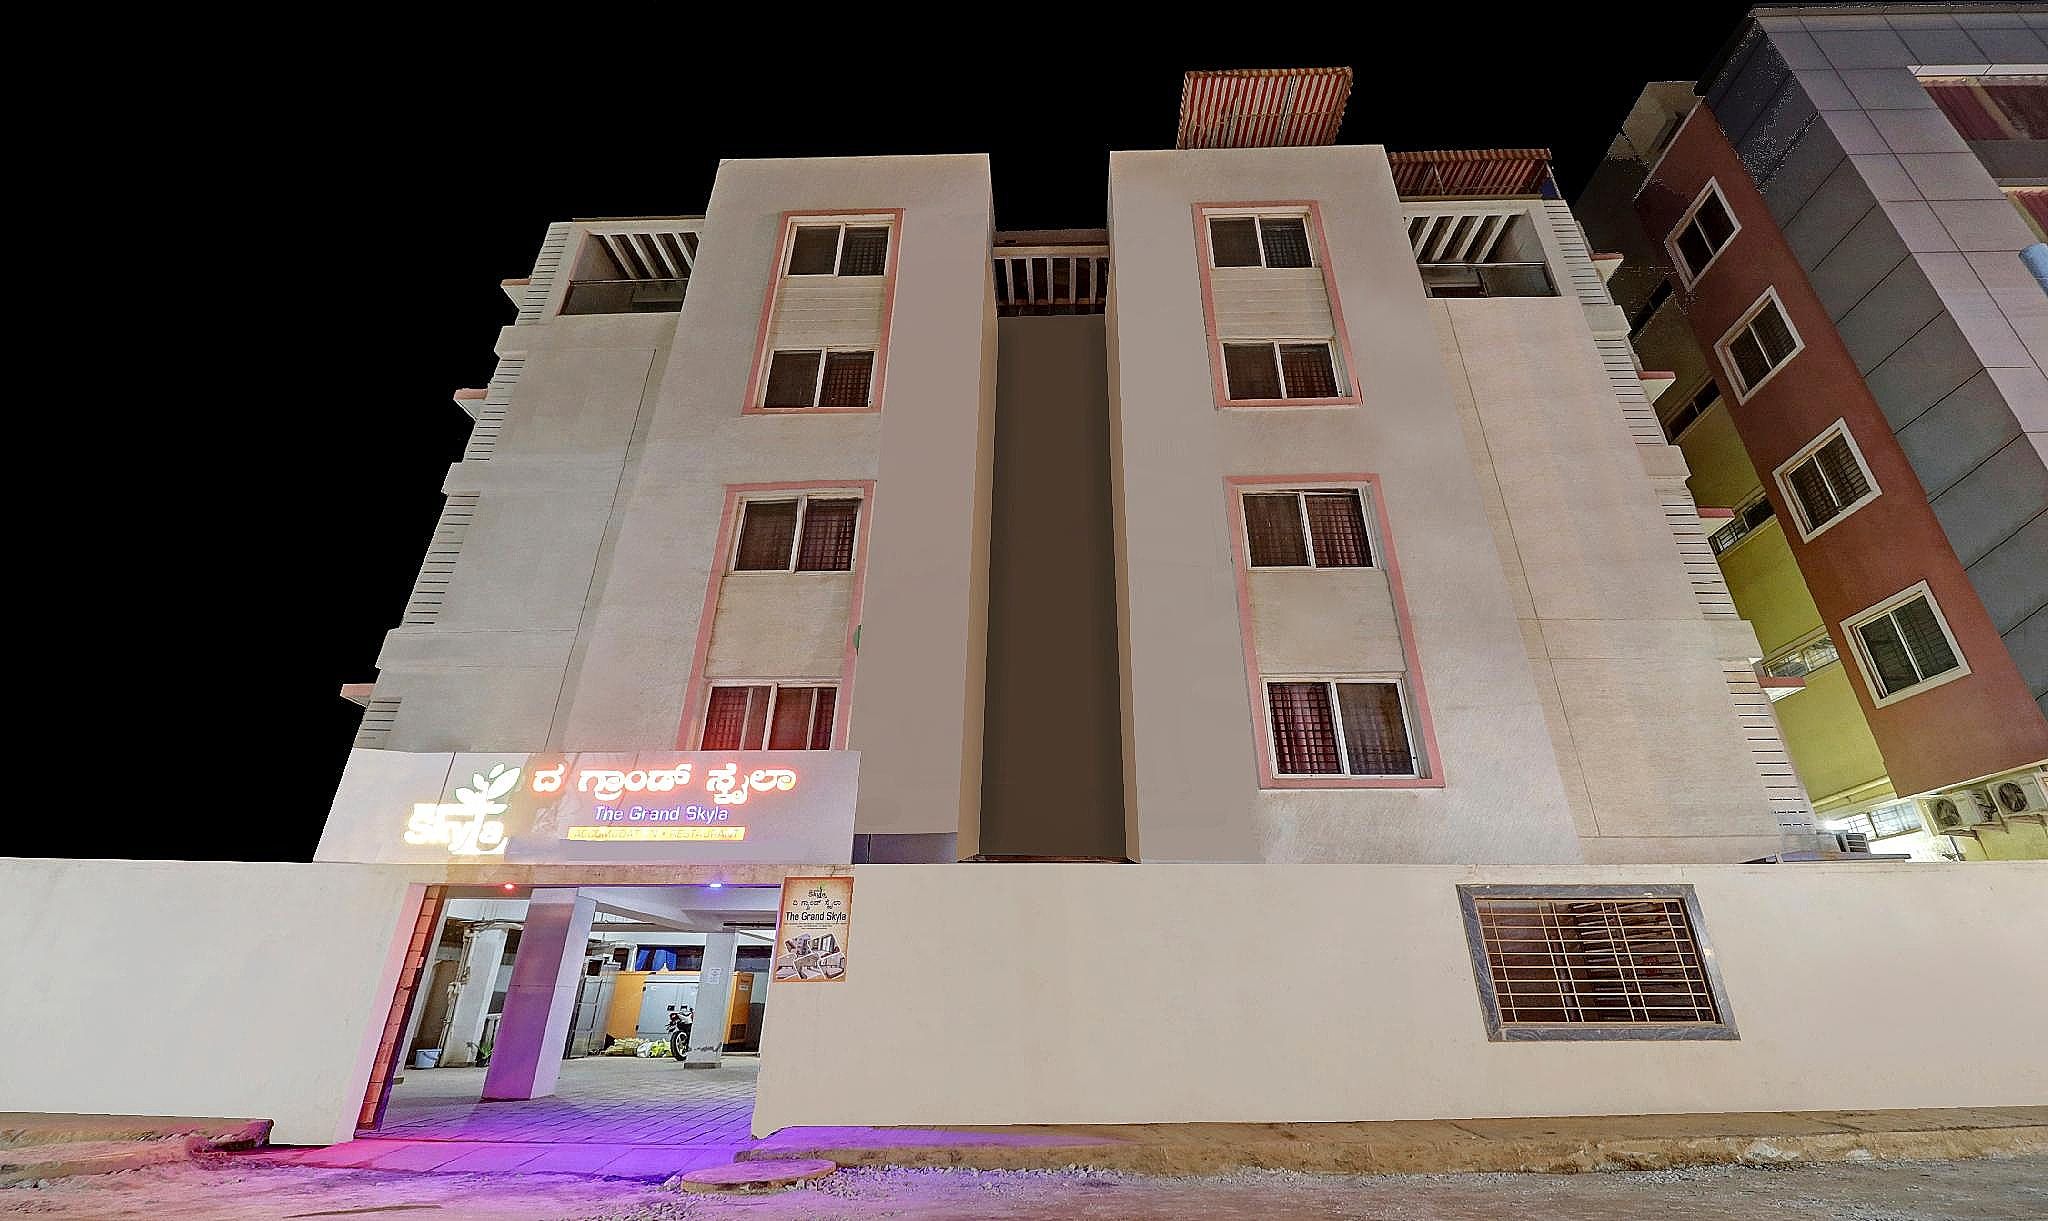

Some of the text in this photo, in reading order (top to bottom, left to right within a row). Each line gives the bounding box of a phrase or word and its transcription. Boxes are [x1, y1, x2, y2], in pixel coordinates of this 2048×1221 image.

[594, 805, 729, 825] The Grand Skyla
[785, 911, 847, 923] The Grand Skyla
